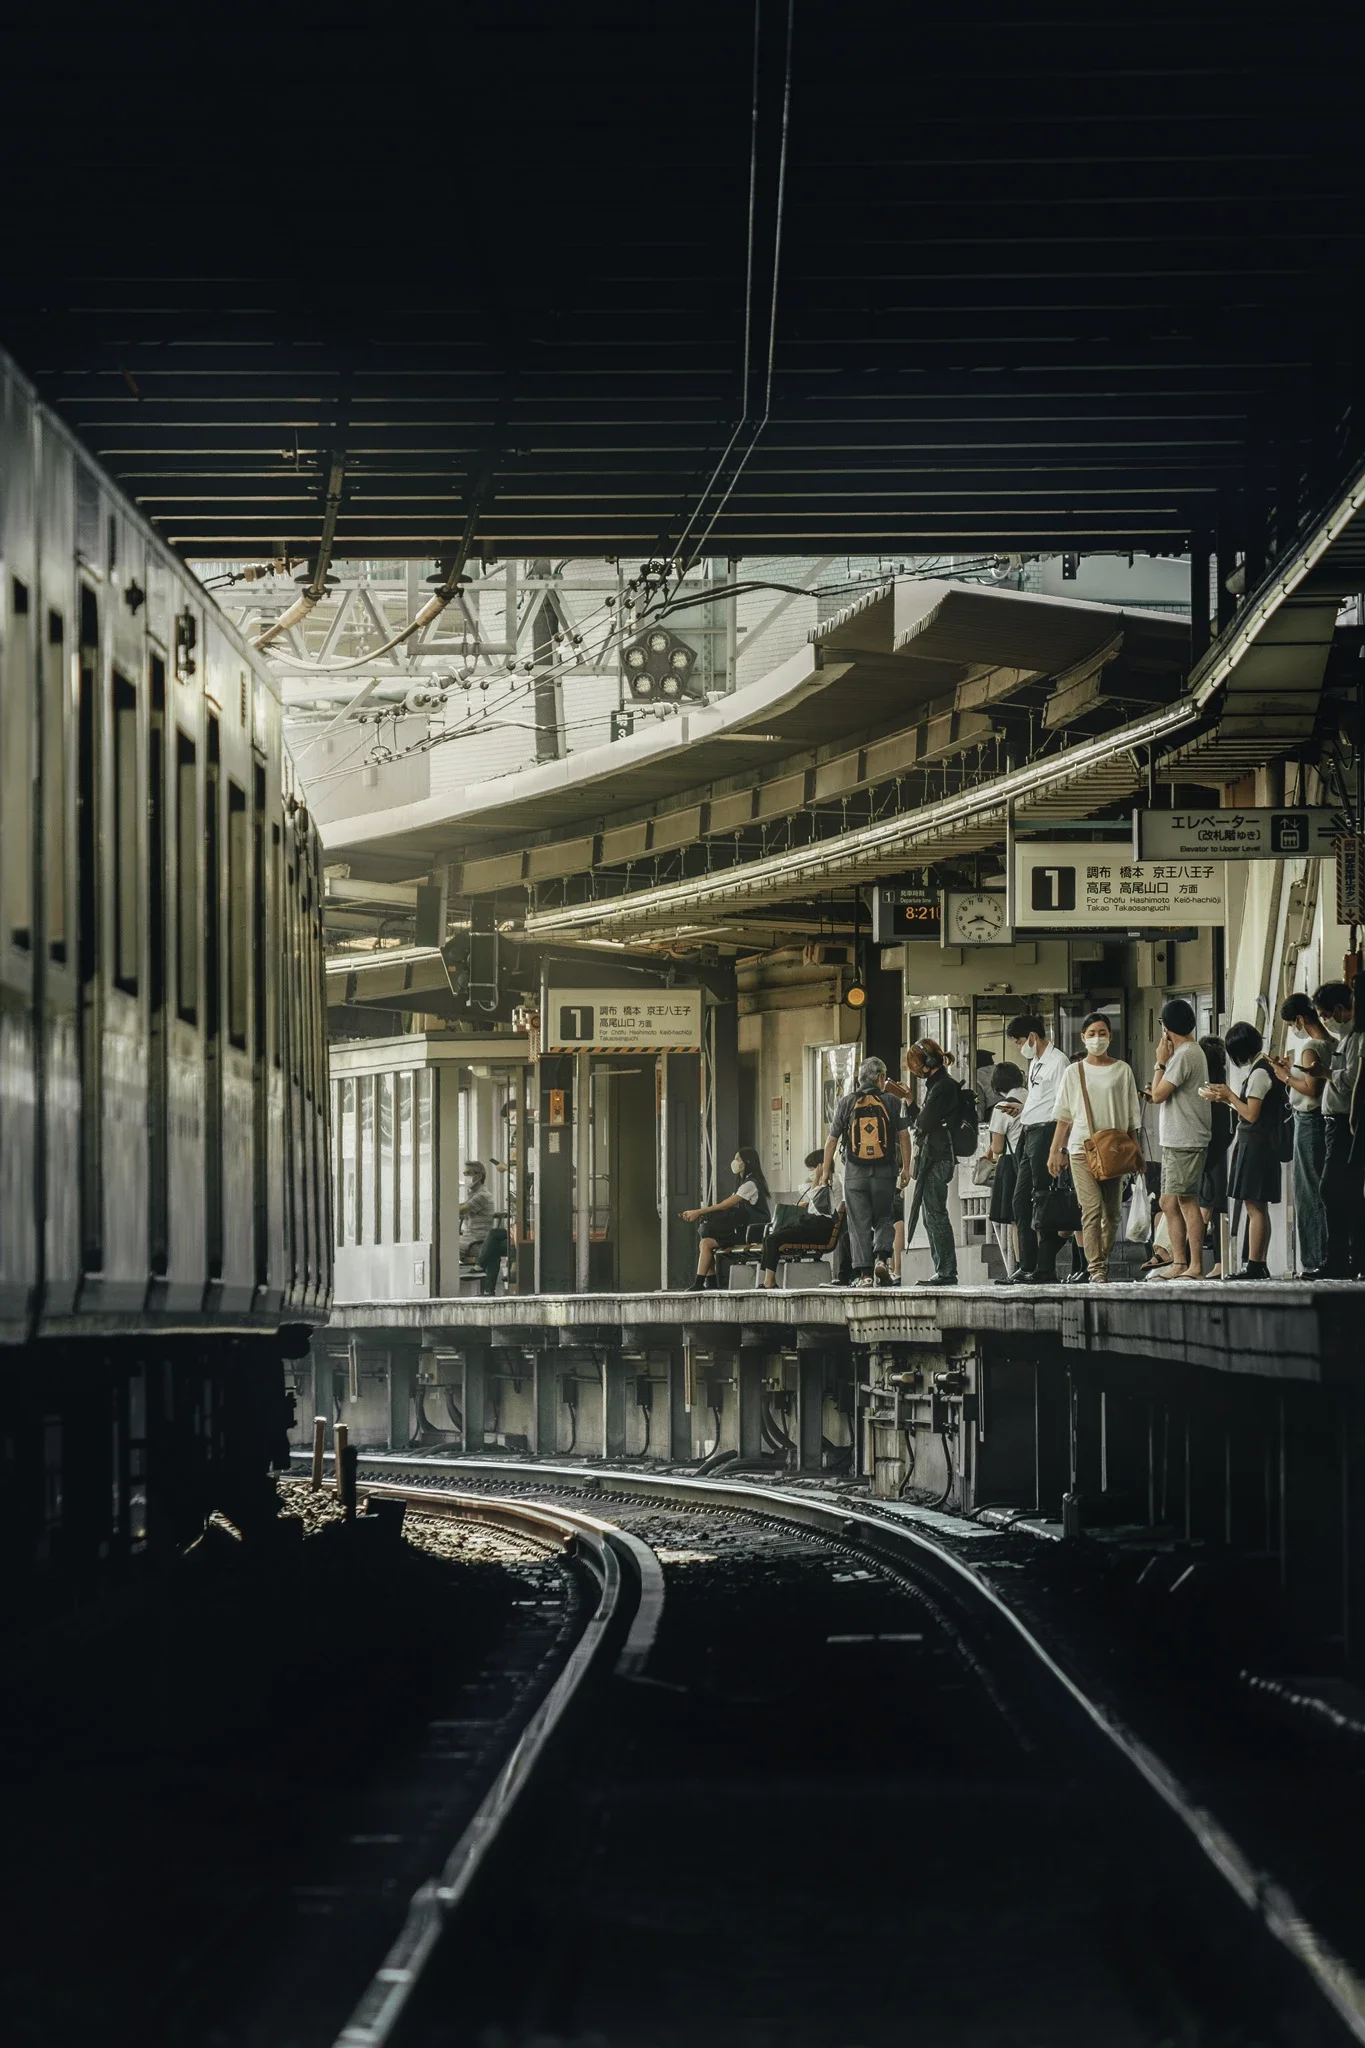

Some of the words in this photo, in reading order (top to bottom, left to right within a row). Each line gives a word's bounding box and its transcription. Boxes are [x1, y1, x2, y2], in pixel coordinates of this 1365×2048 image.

[1171, 815, 1260, 829] エレベーター
[1220, 846, 1240, 854] Upper
[1087, 866, 1111, 879] 調布
[1120, 866, 1144, 879] 橋本
[1153, 866, 1215, 879] 京王八王子
[1045, 870, 1059, 907] 1
[1087, 882, 1111, 894] 高尾
[1120, 882, 1168, 894] 高尾山口
[1179, 884, 1198, 894] 方面
[1130, 896, 1170, 904] Hashimoto
[905, 906, 934, 919] 8:21
[1114, 905, 1171, 913] Takaosanguchi
[600, 1006, 617, 1016] 調布
[623, 1006, 641, 1016] 橋本
[647, 1006, 691, 1016] 京王八王子
[571, 1009, 581, 1038] 1
[600, 1018, 635, 1028] 高尾山口
[638, 1020, 652, 1028] 方面
